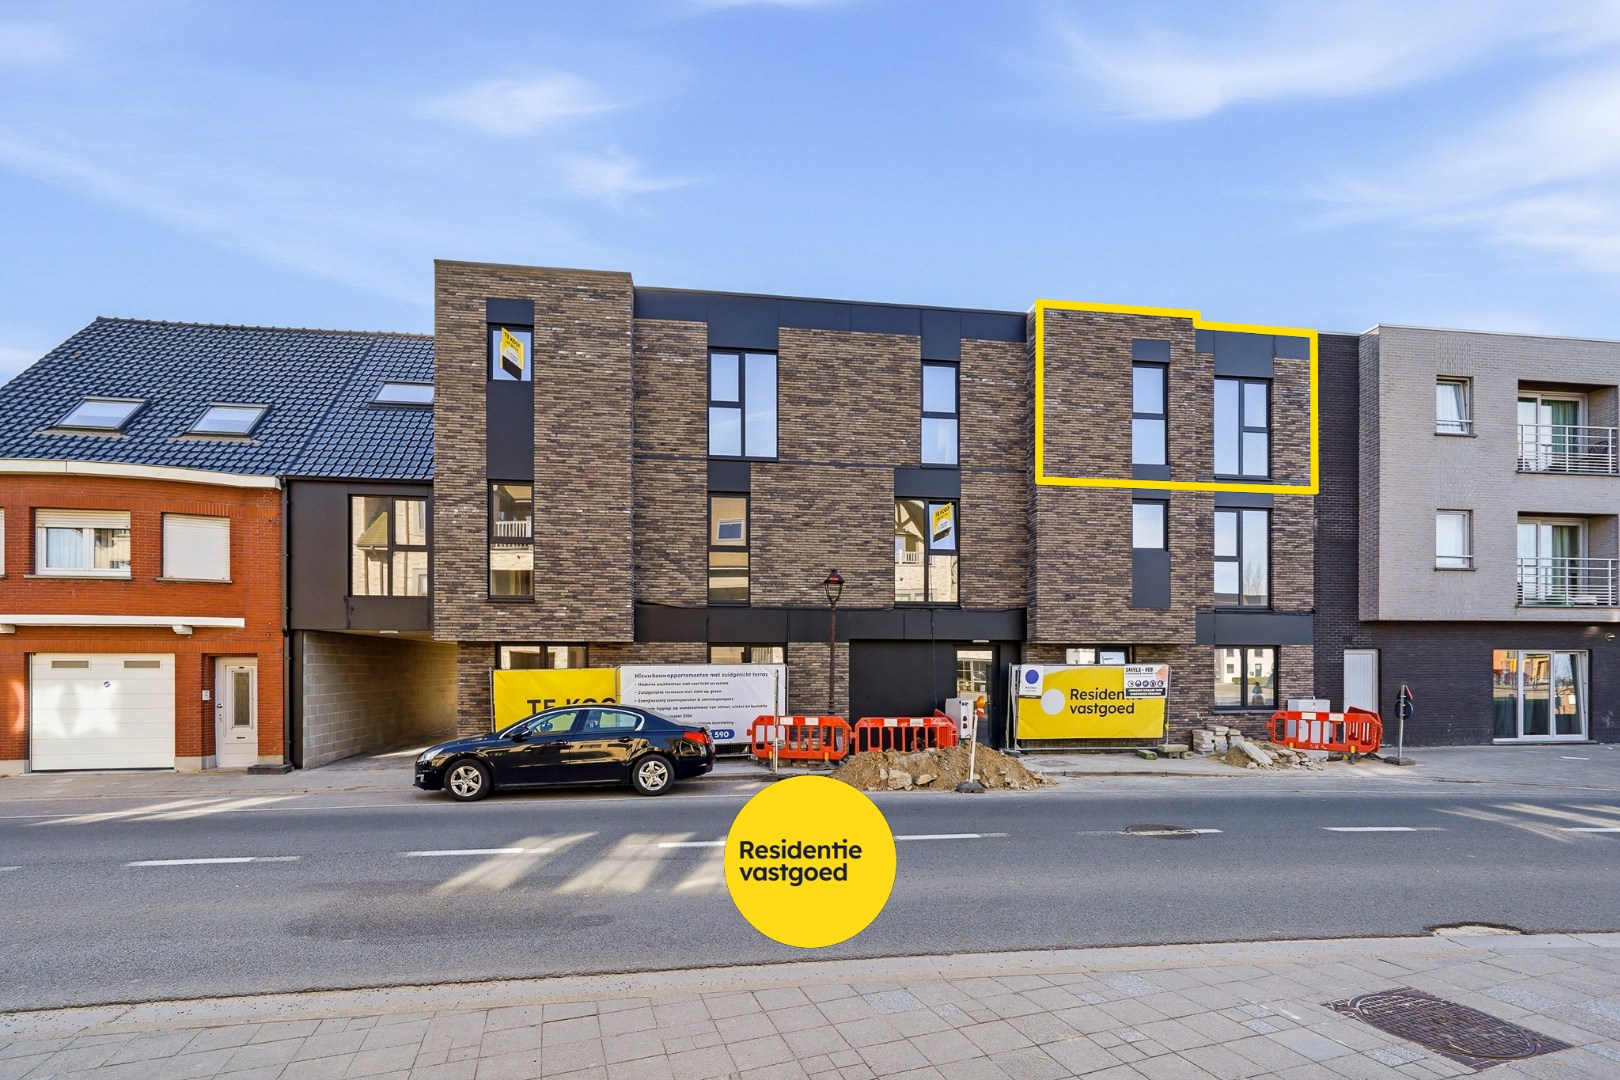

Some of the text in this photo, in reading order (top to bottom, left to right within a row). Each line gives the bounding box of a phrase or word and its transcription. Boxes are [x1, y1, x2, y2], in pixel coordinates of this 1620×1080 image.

[1070, 687, 1143, 700] Residen
[527, 699, 556, 715] TE
[1070, 703, 1135, 718] vastgoed
